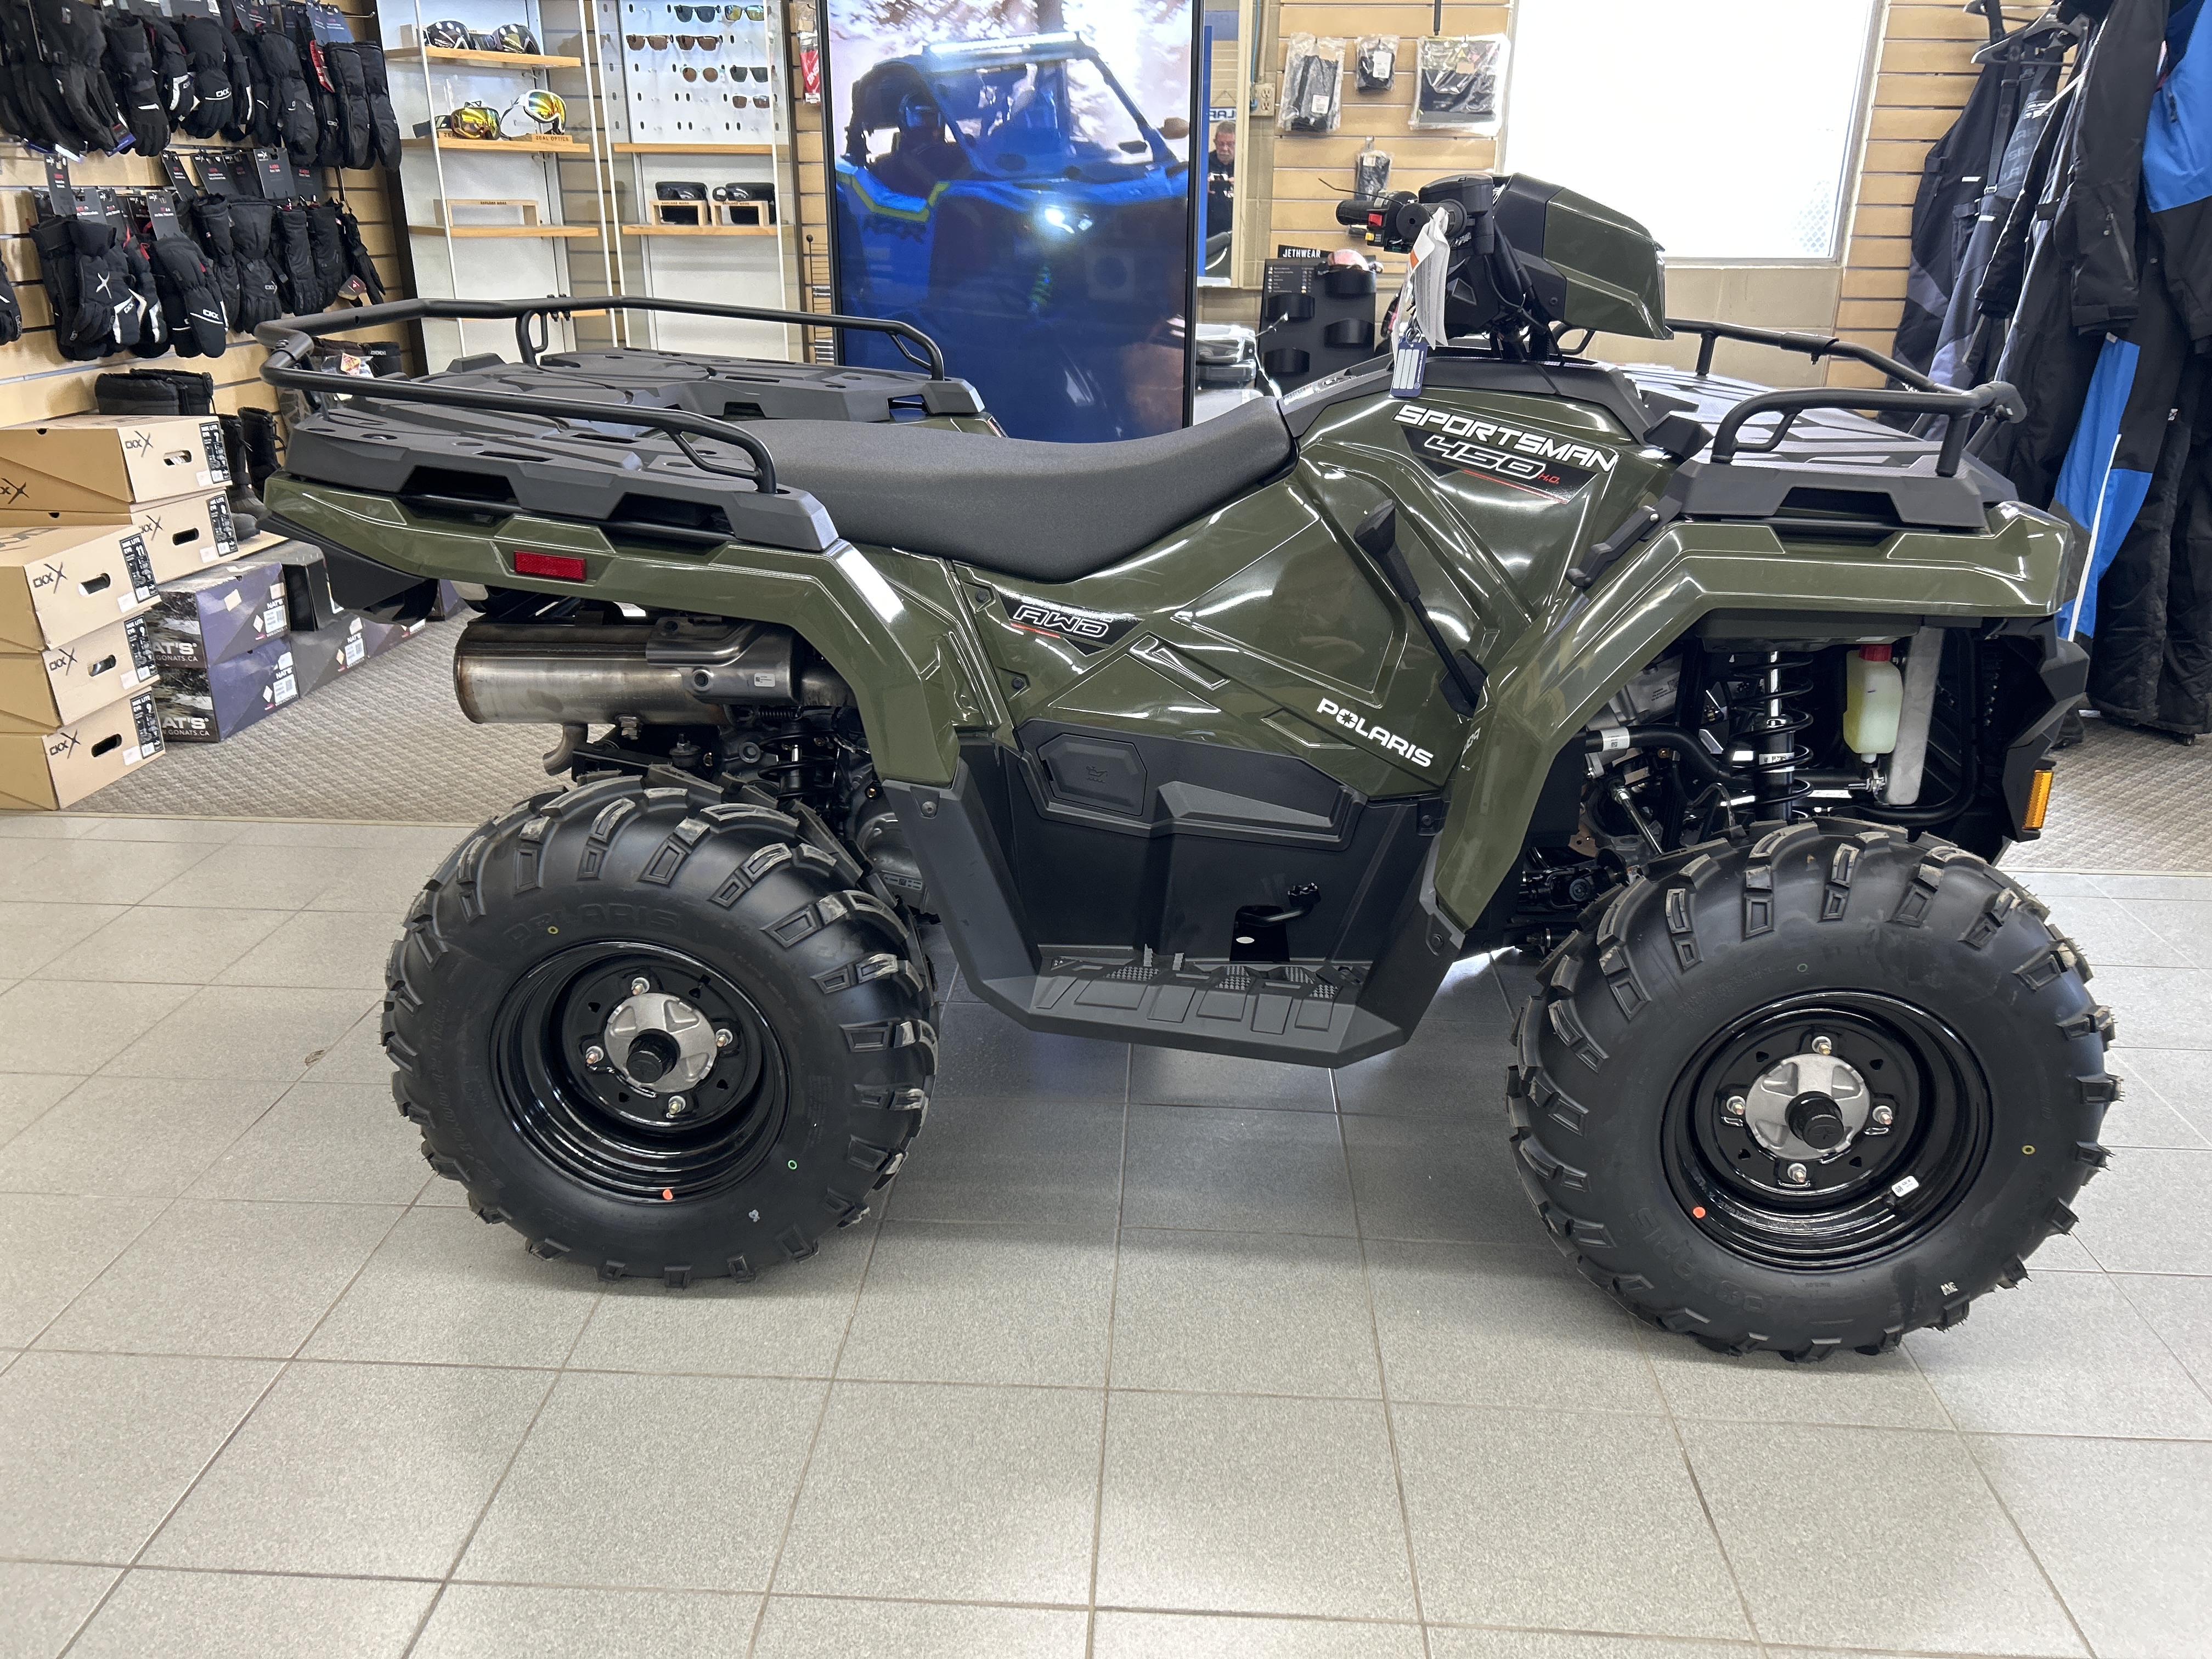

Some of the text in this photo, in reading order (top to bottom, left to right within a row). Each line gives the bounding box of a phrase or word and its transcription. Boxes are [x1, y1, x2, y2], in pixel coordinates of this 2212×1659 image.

[1283, 249, 1321, 258] JETHWEAR
[202, 309, 219, 320] CKX
[213, 432, 219, 442] 7
[1393, 404, 1621, 472] SPORTSMAN
[1424, 435, 1560, 484] 450 H.O.
[221, 505, 227, 514] 8
[136, 545, 144, 556] 11
[1013, 605, 1109, 638] AWD
[139, 627, 145, 636] 9
[153, 642, 195, 655] AT'S
[146, 703, 151, 713] 9
[162, 717, 206, 730] AT'S
[1316, 697, 1434, 769] POLARIS
